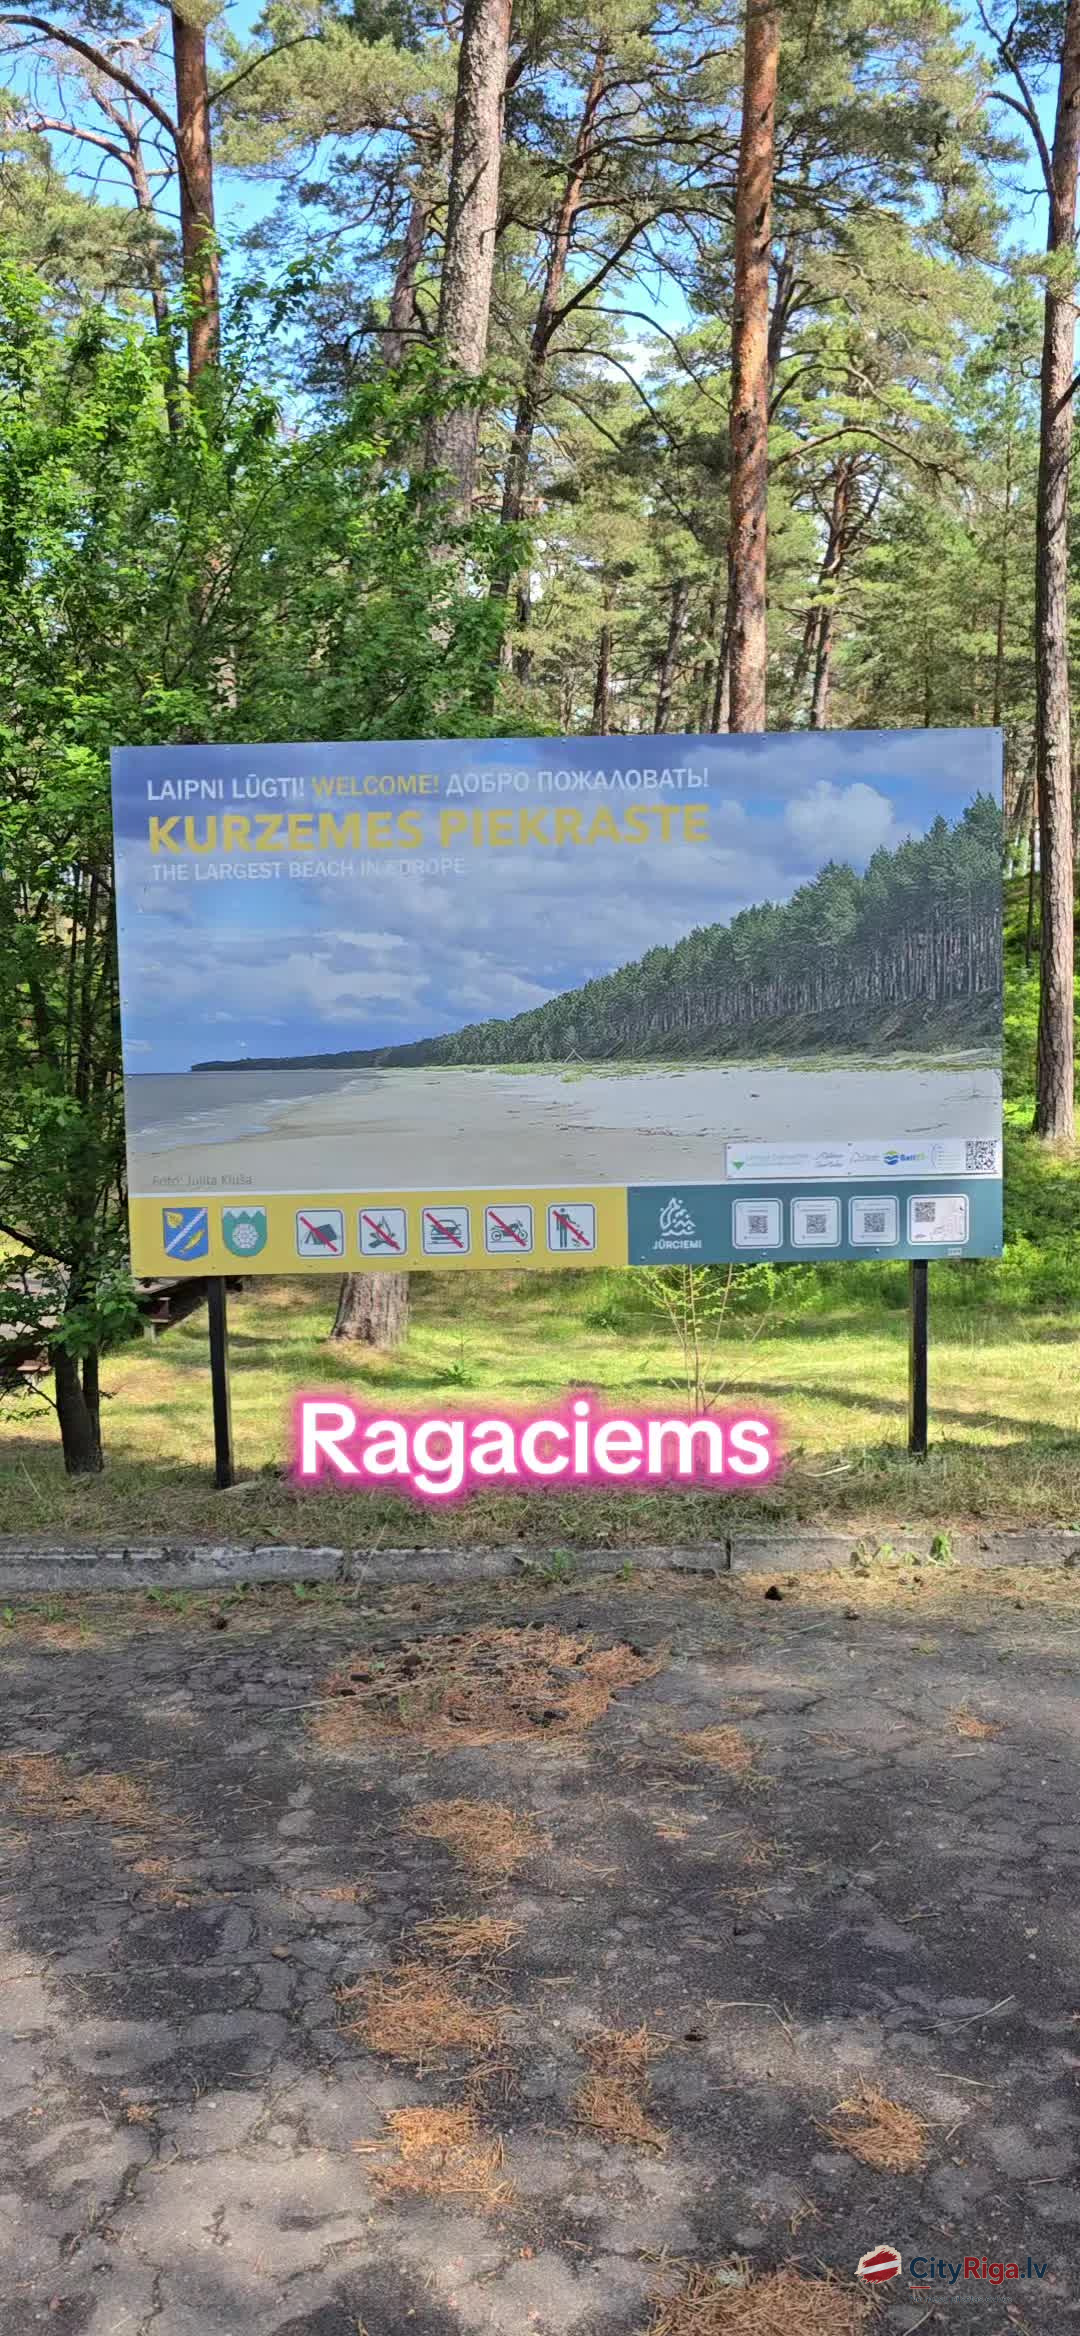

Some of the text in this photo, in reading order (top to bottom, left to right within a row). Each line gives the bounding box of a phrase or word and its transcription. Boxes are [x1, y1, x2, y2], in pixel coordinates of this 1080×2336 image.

[147, 774, 439, 800] LAIPNI LŪGTI! WELCOME!
[446, 768, 709, 797] ДОБРО ПОЖАЛОВАТЬ!
[149, 804, 711, 854] KURZEMES PIEKRASTE
[151, 864, 189, 880] THE
[195, 862, 281, 880] LARGEST
[289, 859, 352, 878] BEACH
[361, 858, 380, 876] IN
[652, 1238, 702, 1250] JŪRCIEMI
